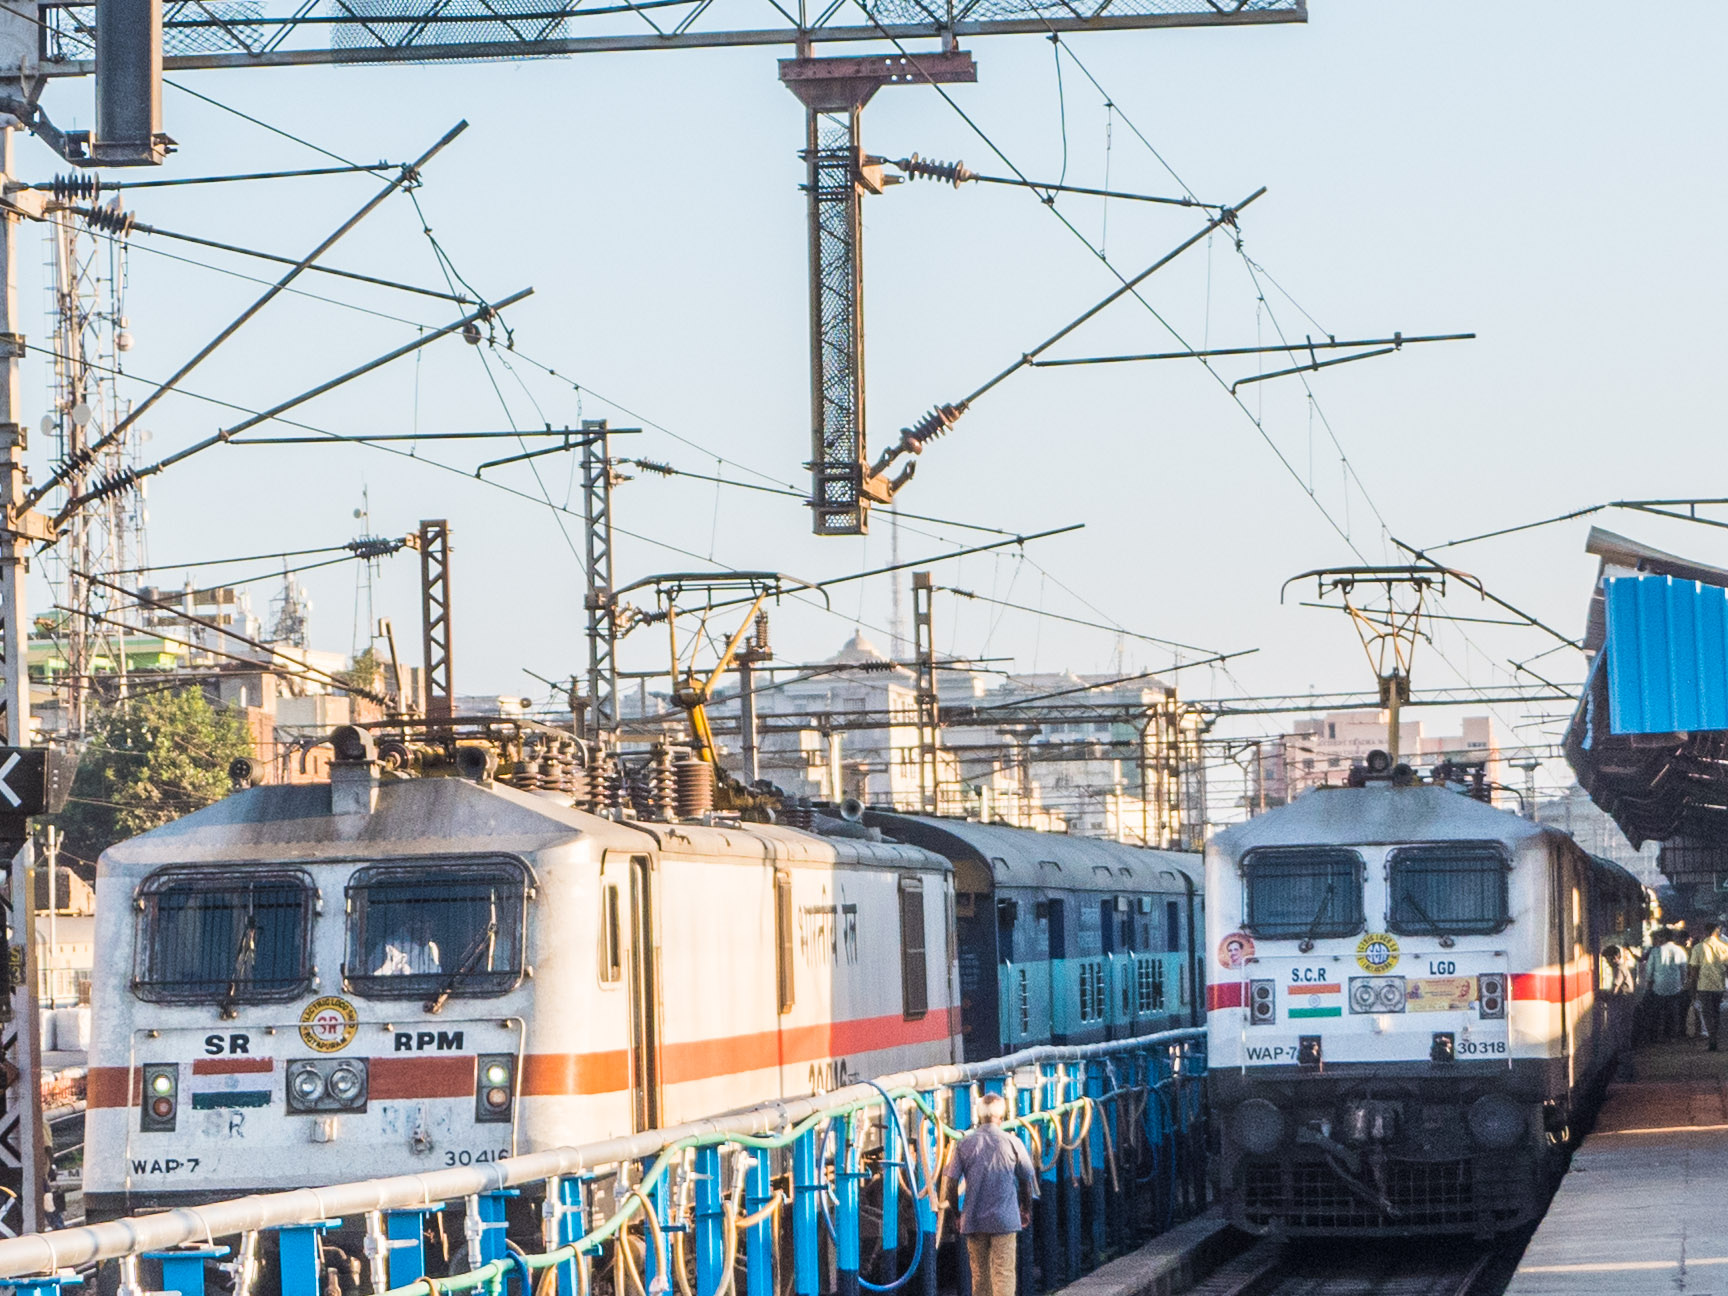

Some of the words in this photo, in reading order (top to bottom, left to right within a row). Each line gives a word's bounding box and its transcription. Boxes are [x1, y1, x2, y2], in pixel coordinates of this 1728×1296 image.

[1430, 961, 1456, 975] LGD
[205, 1034, 250, 1054] SR
[394, 1031, 464, 1051] RPM
[1457, 1043, 1505, 1054] 30318
[445, 1150, 509, 1166] 30416
